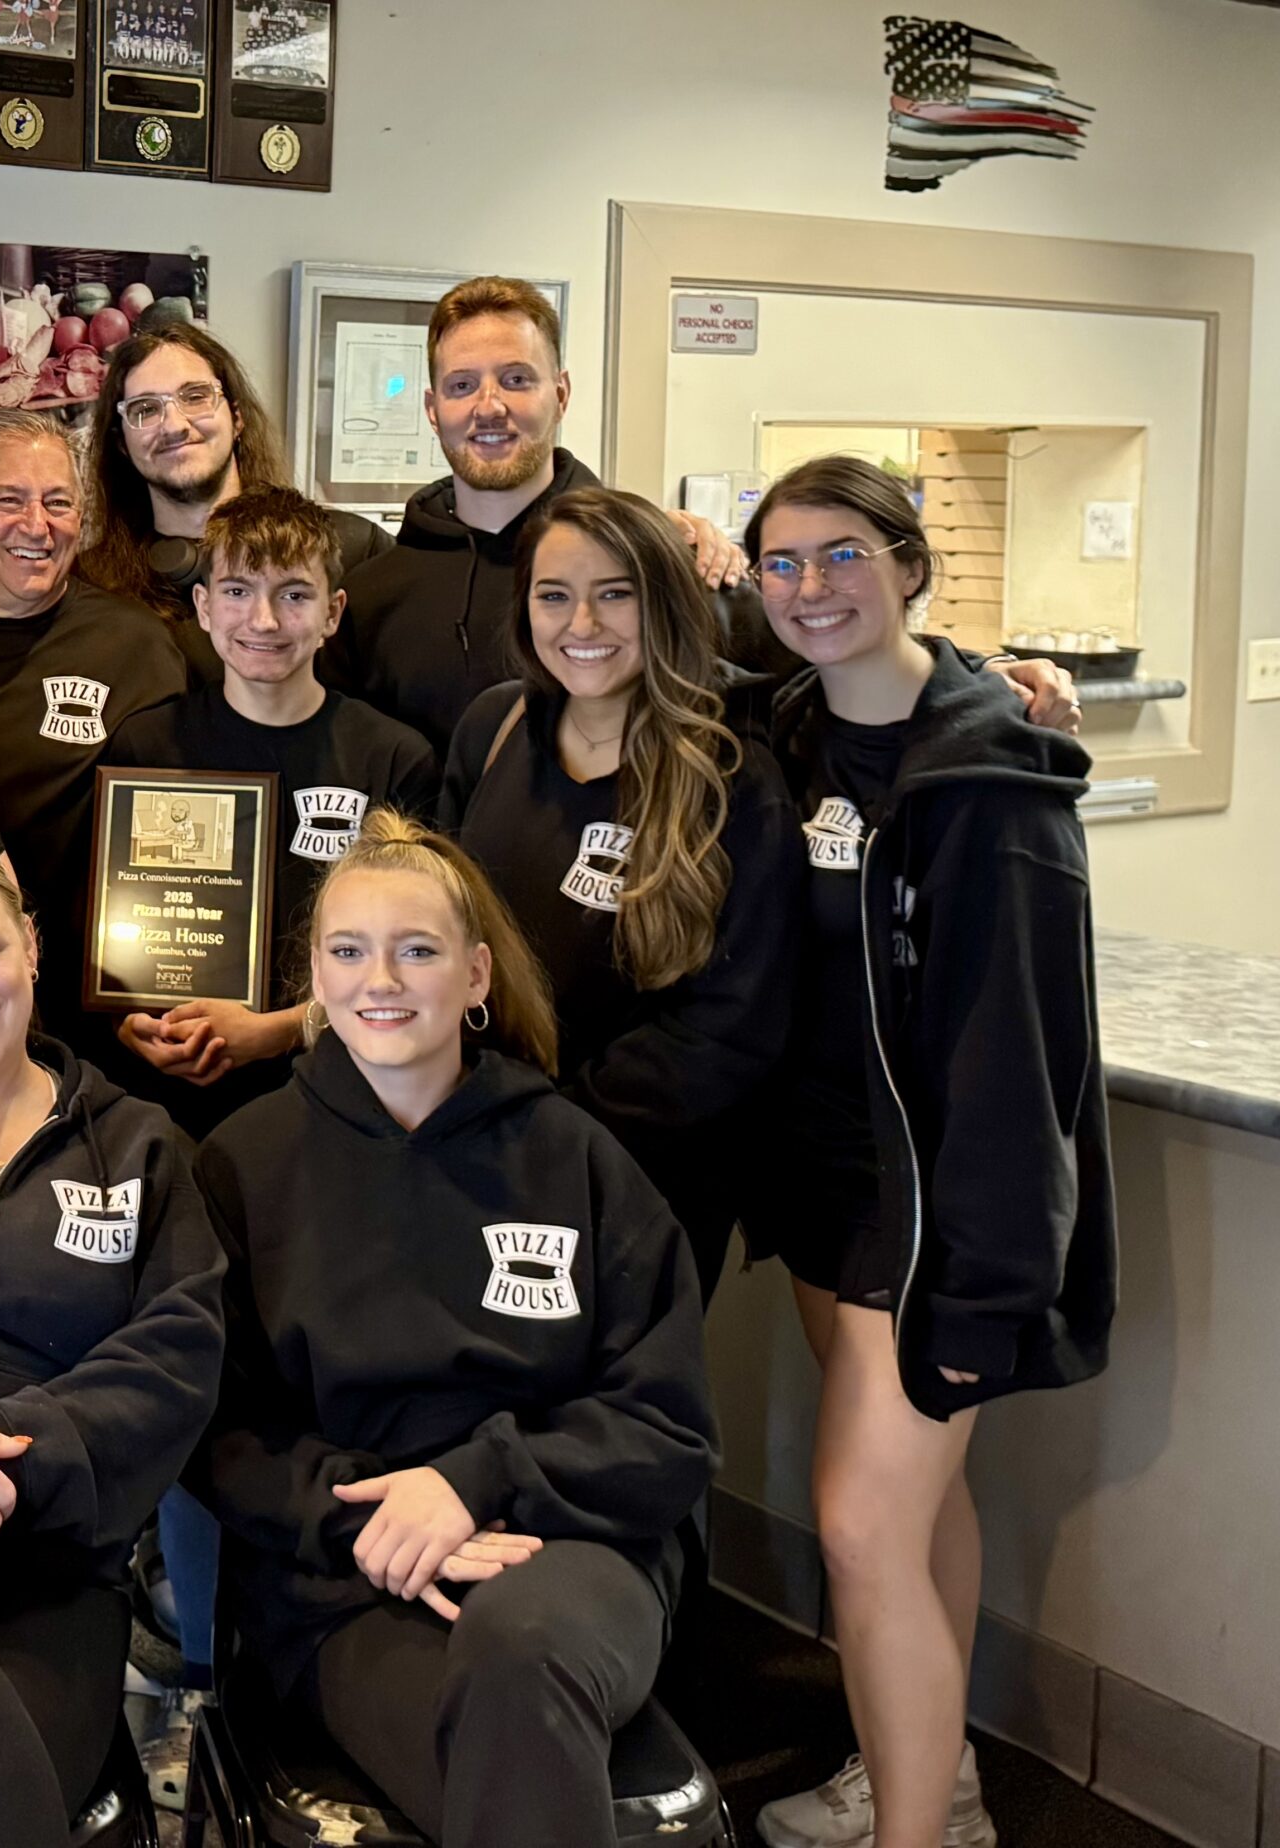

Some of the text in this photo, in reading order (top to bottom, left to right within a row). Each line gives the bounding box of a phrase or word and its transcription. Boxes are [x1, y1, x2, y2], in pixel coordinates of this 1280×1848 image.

[710, 304, 723, 314] NO
[679, 317, 753, 330] PERSONAL CHECKS
[695, 333, 736, 344] ACCEPTED
[50, 681, 100, 704] PIZZA
[47, 716, 99, 739] HOUSE
[302, 793, 358, 816] PIZZA
[587, 828, 632, 854] PIZZ
[118, 871, 243, 886] Pizza Connoisseurs of Columbus
[568, 869, 620, 904] HOUS
[163, 890, 193, 904] 2025
[133, 904, 223, 920] Pizza of the Year
[175, 927, 225, 945] House
[144, 945, 207, 957] Columbus, Ohio
[63, 1187, 130, 1208] PIZZA
[65, 1222, 132, 1254] HOUSE
[495, 1231, 564, 1259] PIZZA
[493, 1280, 569, 1310] HOUSE
